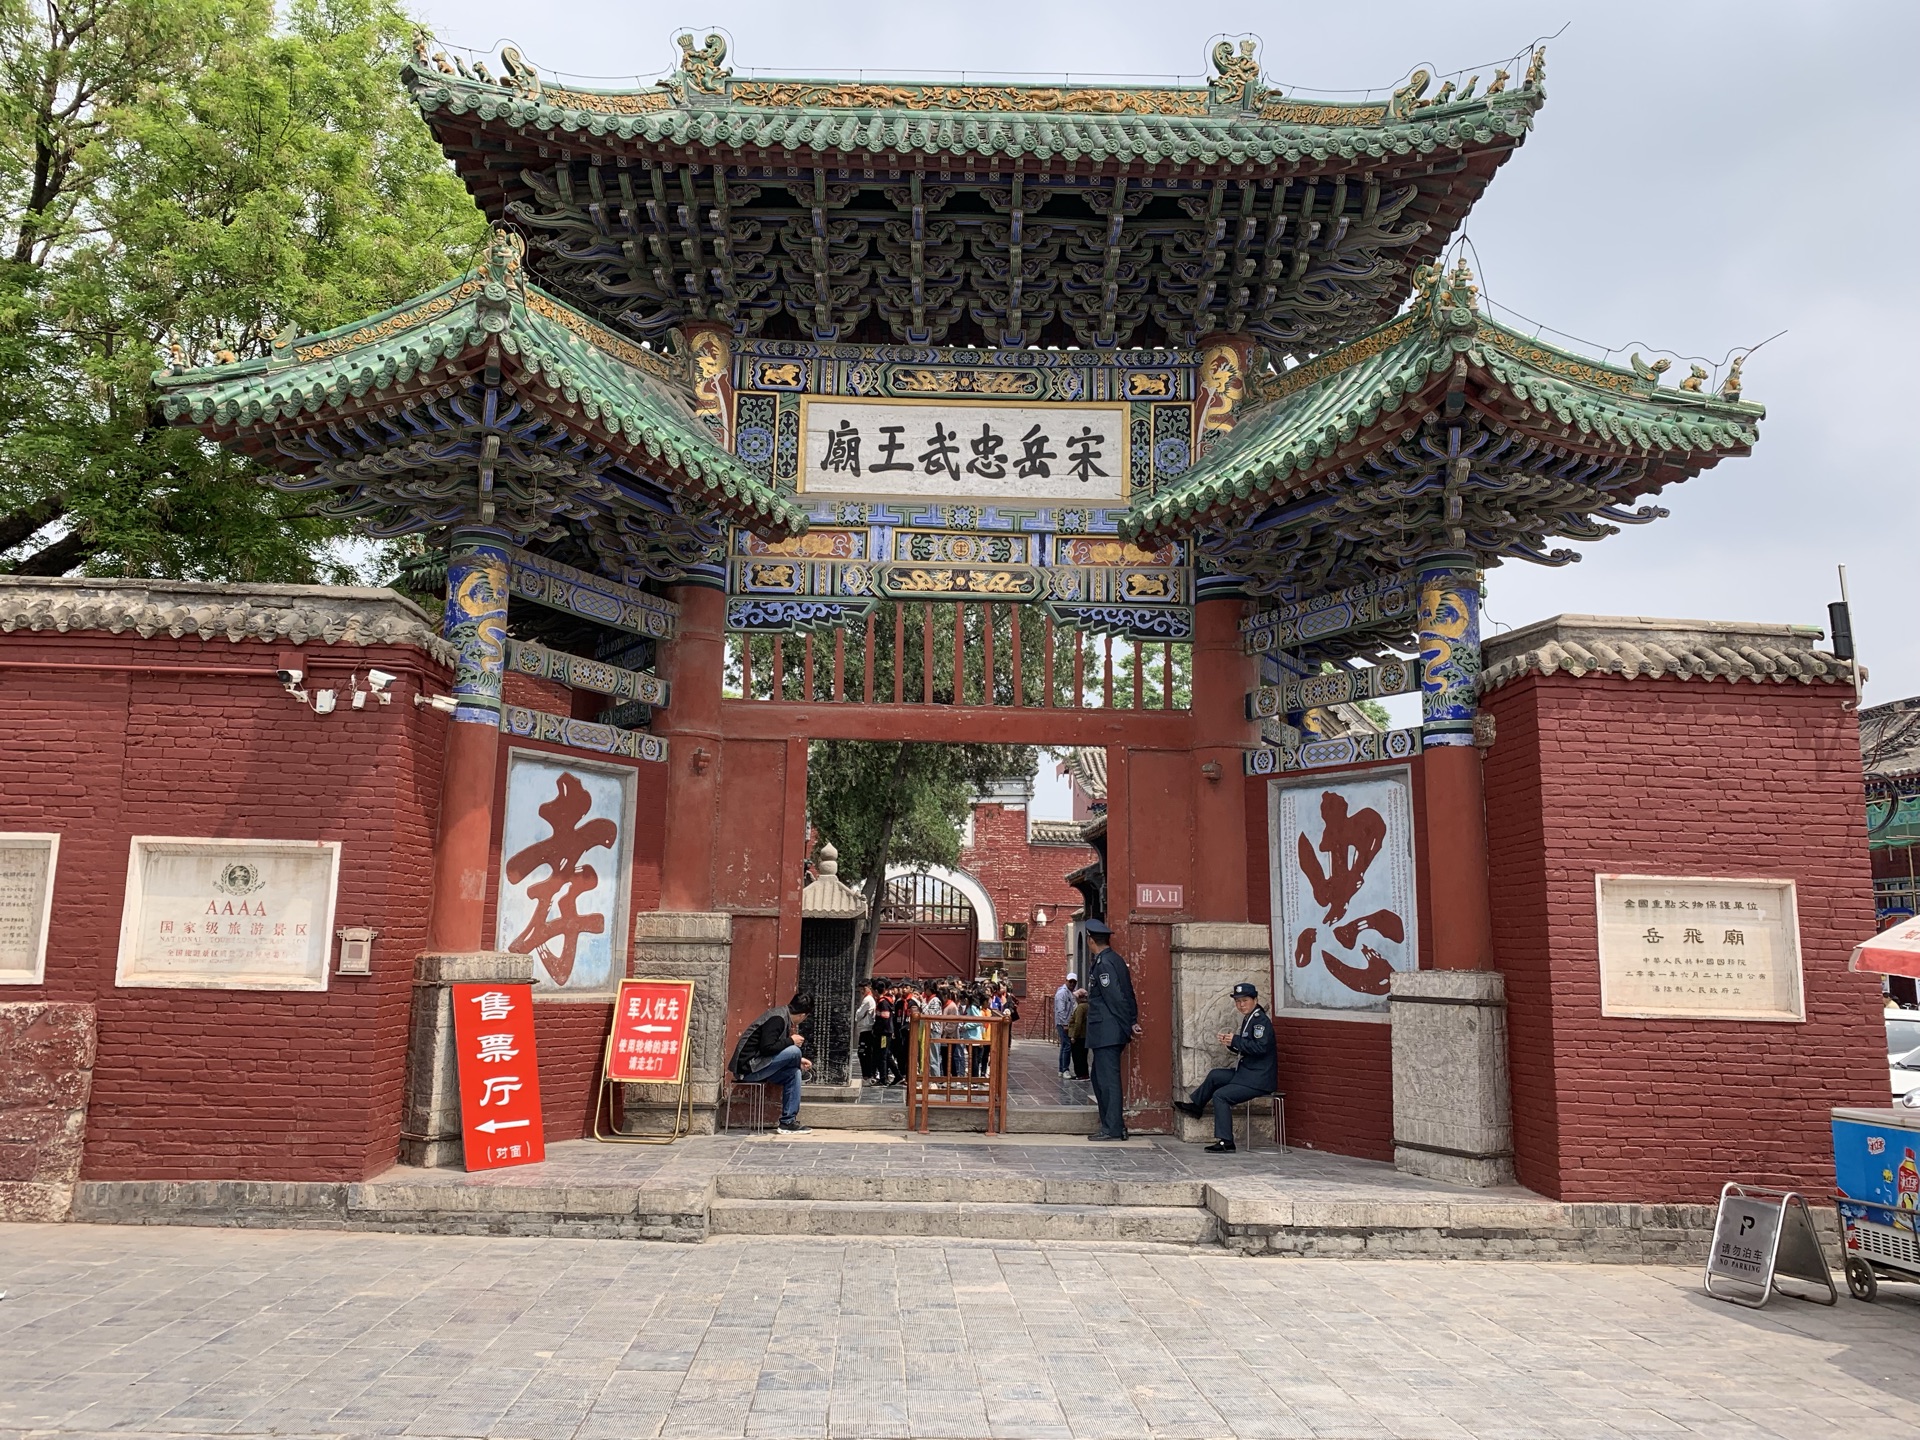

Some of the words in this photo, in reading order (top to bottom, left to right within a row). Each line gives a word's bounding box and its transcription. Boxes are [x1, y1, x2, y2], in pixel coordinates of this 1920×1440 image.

[1142, 888, 1178, 903] 出入口
[1294, 790, 1404, 996] 忠
[205, 899, 267, 917] AAAA
[160, 920, 308, 937] 国家级旅游景区
[1642, 927, 1745, 946] 岳飛廟
[627, 997, 679, 1020] 军人优先
[471, 991, 522, 1107] 售票厅
[618, 1038, 678, 1055] 使用轮椅的游客
[628, 1055, 663, 1072] 请走北门
[1739, 1215, 1756, 1236] P
[1721, 1242, 1763, 1261] 请勿泊车
[1719, 1257, 1729, 1266] NO
[1731, 1260, 1761, 1274] PARKING
